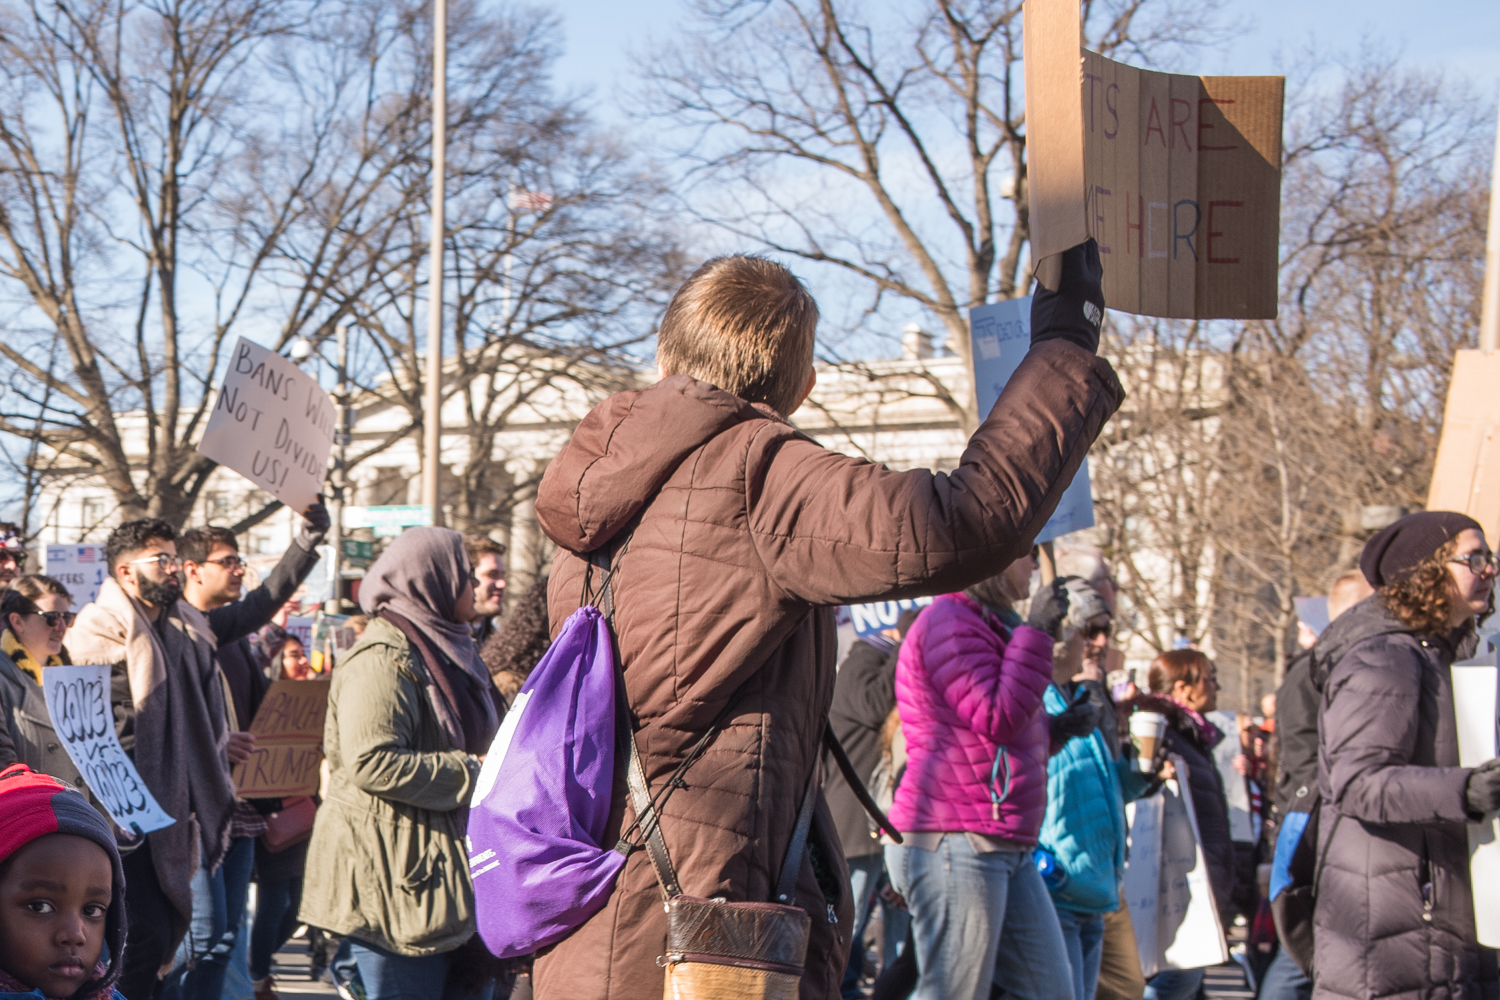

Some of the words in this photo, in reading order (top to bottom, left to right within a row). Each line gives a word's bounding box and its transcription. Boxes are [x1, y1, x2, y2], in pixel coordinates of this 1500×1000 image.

[1145, 95, 1238, 153] ARE
[1125, 190, 1244, 264] HERE
[235, 343, 296, 401] BANS
[217, 384, 264, 431] NOT
[251, 450, 289, 494] US!
[238, 746, 320, 788] TRUMP
